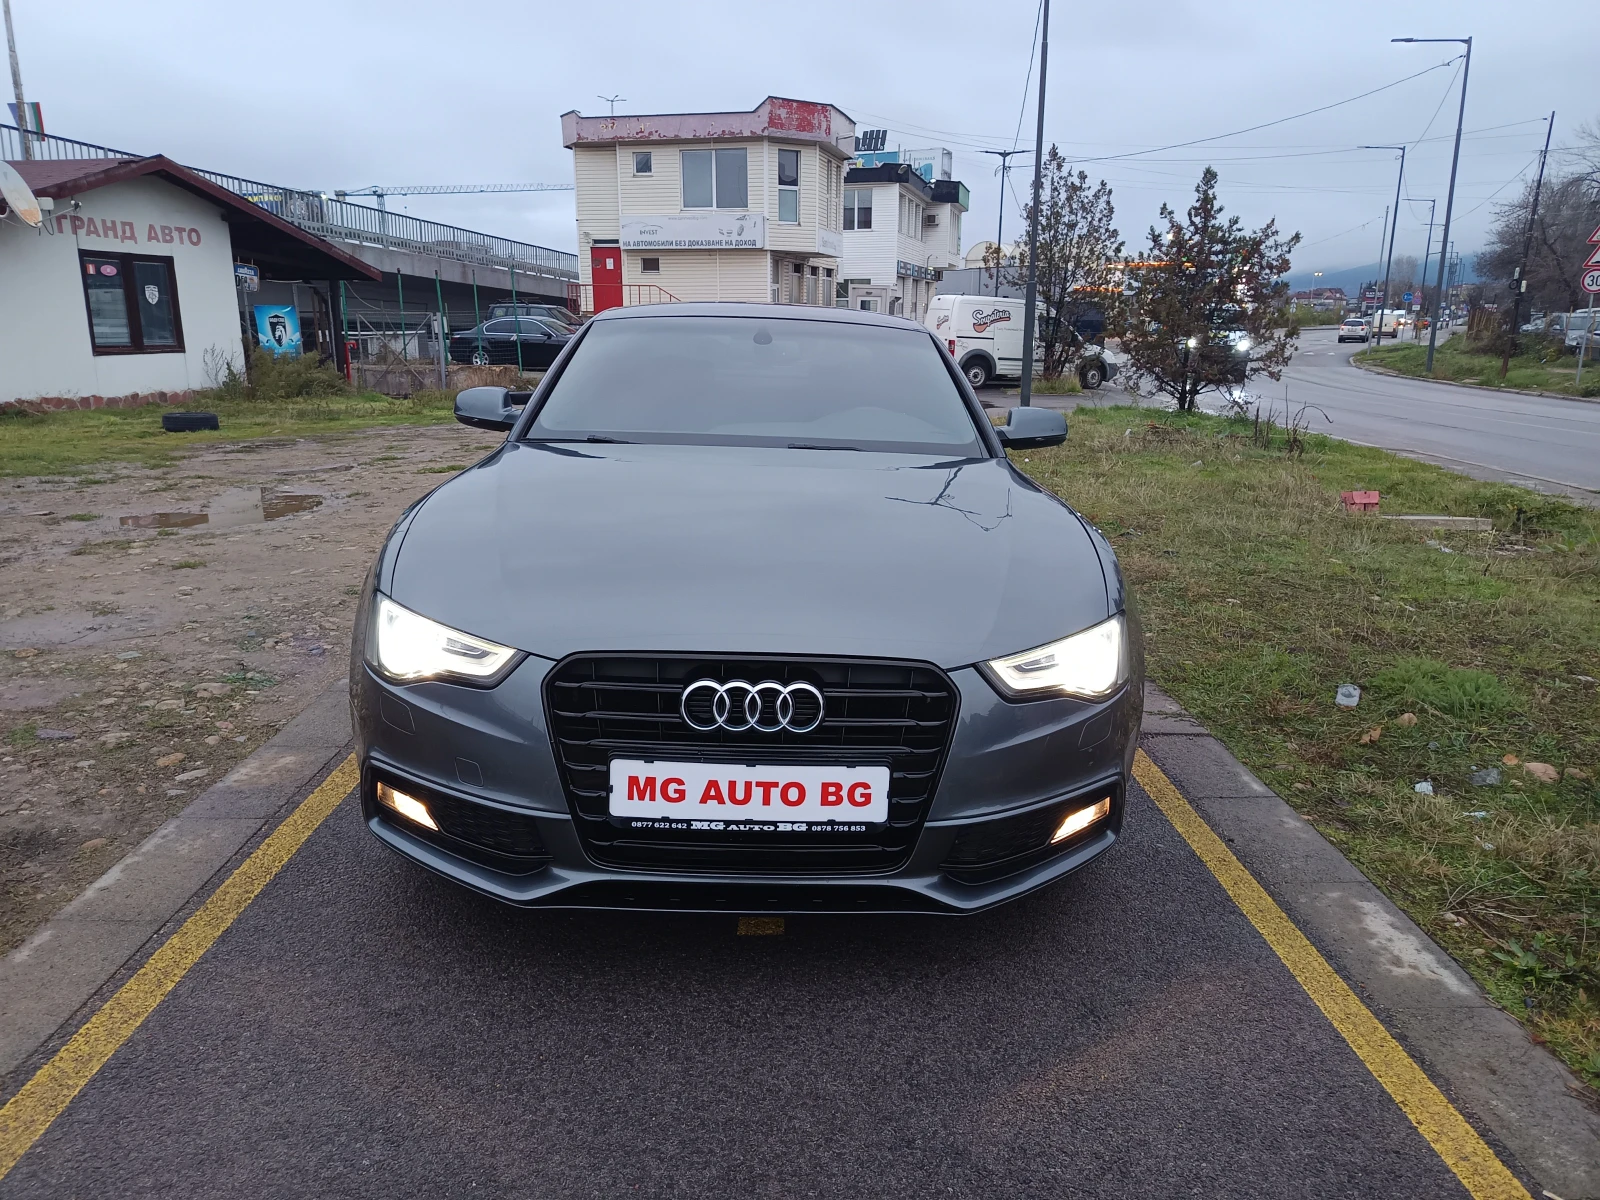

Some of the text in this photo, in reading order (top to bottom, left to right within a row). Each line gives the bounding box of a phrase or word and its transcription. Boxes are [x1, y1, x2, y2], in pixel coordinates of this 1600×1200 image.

[55, 214, 202, 247] ГРАНД АВТО
[632, 240, 674, 248] АВТОМОБИЛИ
[687, 239, 723, 248] ДОКАЗВАНЕ
[724, 239, 734, 247] НА
[734, 239, 757, 248] ДОХОД
[1587, 274, 1600, 287] 30
[627, 776, 872, 807] MG AUTO BG
[690, 821, 726, 831] MG
[776, 822, 808, 832] BG
